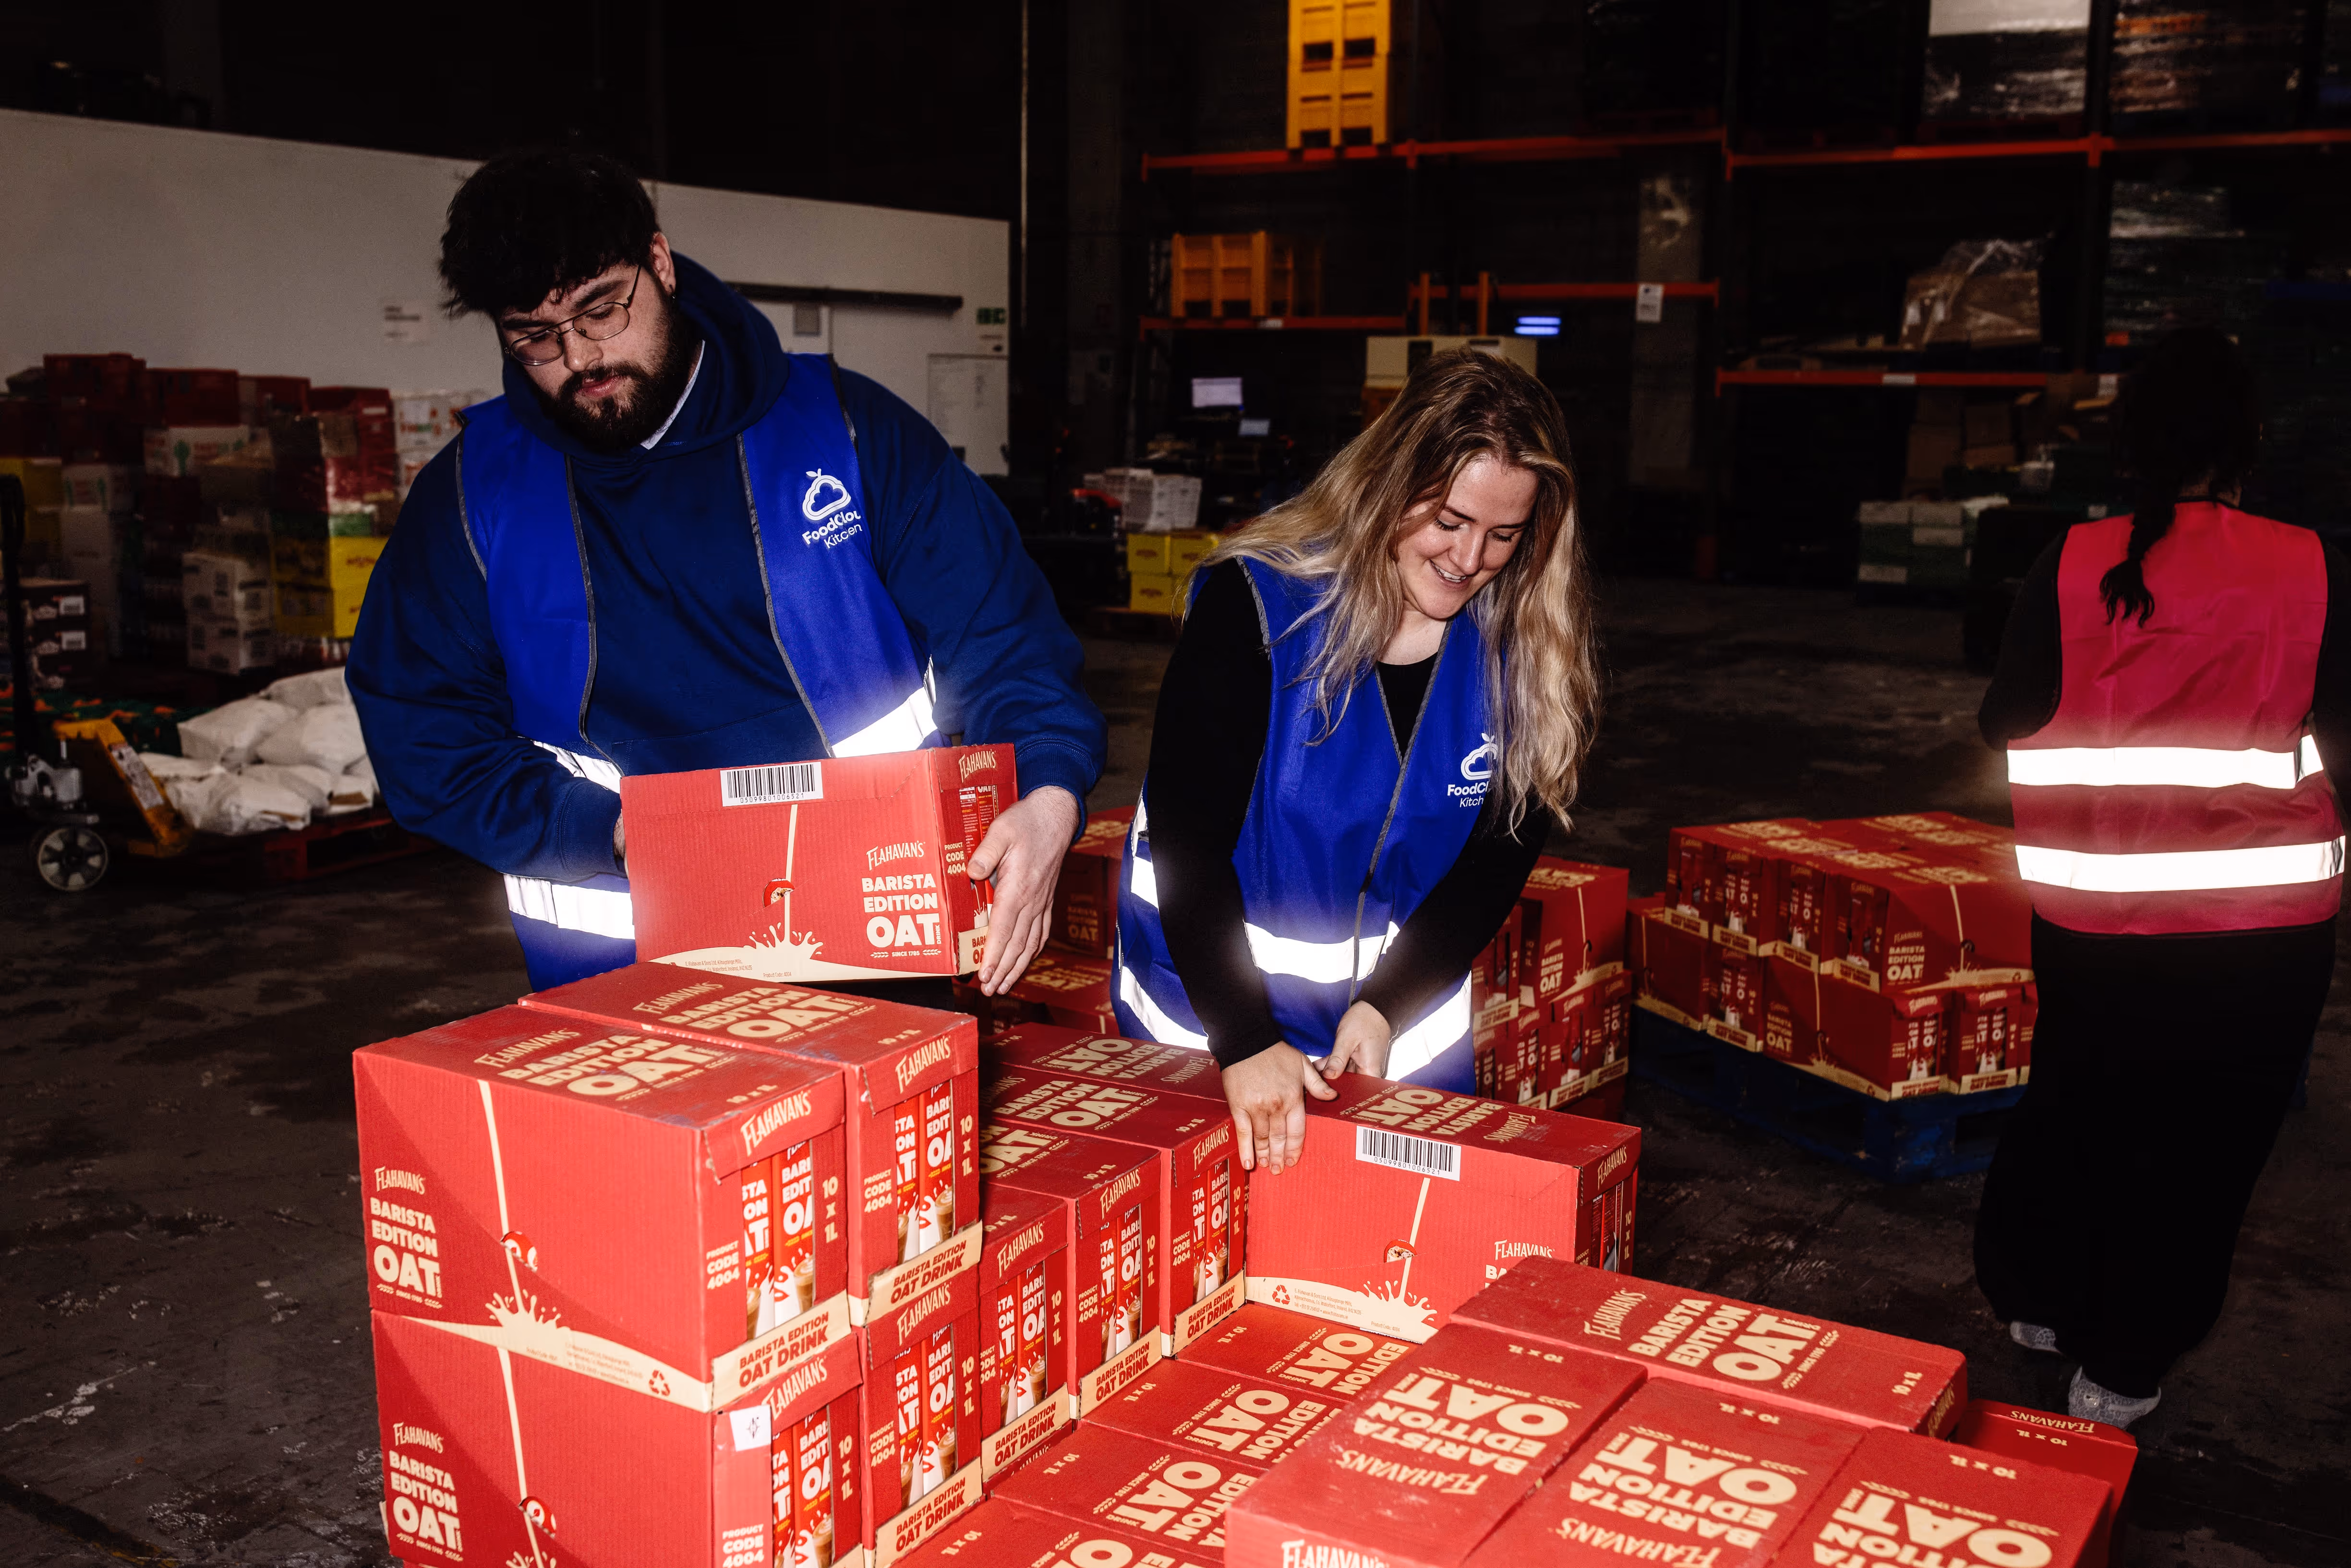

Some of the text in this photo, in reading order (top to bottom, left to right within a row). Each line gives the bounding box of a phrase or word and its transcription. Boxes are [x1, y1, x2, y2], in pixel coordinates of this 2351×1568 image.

[823, 524, 863, 549] Kitcen
[958, 749, 996, 783] FLAHAVAN'S
[740, 792, 805, 804] 05099801006521
[866, 840, 926, 871] FLAHAVAN'S
[944, 842, 963, 850] PRODUCT
[946, 851, 965, 862] CODE
[861, 873, 936, 893] BARISTA
[947, 862, 966, 875] 4004
[863, 893, 938, 913] EDITION
[866, 913, 940, 948] OAT
[1888, 954, 1925, 965] EDITION
[1889, 945, 1925, 954] BARISTA
[1540, 972, 1562, 993] OAT
[1887, 964, 1924, 980] OAT
[659, 987, 781, 1024] BARISTA
[687, 990, 811, 1030] EDITION
[726, 995, 855, 1037] OAT
[498, 1035, 641, 1079] BARISTA
[1049, 1039, 1133, 1072] OAT
[1767, 1032, 1792, 1052] OAT
[528, 1039, 672, 1086] EDITION
[567, 1044, 715, 1095] OAT
[1087, 1043, 1164, 1076] EDITION
[1112, 1048, 1187, 1079] BARISTA
[993, 1080, 1074, 1114] BARISTA
[1016, 1083, 1101, 1120] EDITION
[1050, 1087, 1143, 1126] OAT
[1357, 1089, 1444, 1126] OAT
[1401, 1096, 1477, 1131] EDITION
[1430, 1102, 1505, 1136] BARISTA
[864, 1169, 892, 1185] PRODUCT
[1374, 1157, 1441, 1175] 05099801006521
[864, 1179, 892, 1199] CODE
[864, 1193, 892, 1213] 4004
[370, 1197, 436, 1233] BARISTA
[372, 1219, 438, 1257] EDITION
[706, 1240, 739, 1260] PRODUCT
[1173, 1230, 1190, 1245] PRODUCT
[1173, 1239, 1190, 1255] CODE
[374, 1245, 440, 1296] OAT
[707, 1252, 739, 1274] CODE
[1172, 1250, 1191, 1266] 4004
[707, 1267, 740, 1290] 4004
[891, 1253, 965, 1303] OAT DRINK
[1078, 1285, 1097, 1300] PRODUCT
[1079, 1293, 1097, 1311] CODE
[1079, 1304, 1098, 1323] 4004
[1187, 1295, 1234, 1339] OAT DRINK
[1321, 1301, 1336, 1309] Waterford,
[1627, 1298, 1713, 1358] BARISTA
[1665, 1304, 1752, 1367] EDITION
[739, 1326, 828, 1387] OAT DRINK
[1284, 1333, 1374, 1388] OAT
[1712, 1313, 1818, 1382] OAT
[1096, 1352, 1149, 1401] OAT DRINK
[1278, 1373, 1309, 1384] DRINK
[1330, 1342, 1410, 1395] EDITION
[1191, 1389, 1290, 1452] OAT
[1383, 1376, 1569, 1436] OAT
[870, 1421, 894, 1441] PRODUCT
[870, 1431, 894, 1454] CODE
[995, 1443, 1020, 1467] OAT
[1020, 1413, 1055, 1450] DRINK
[1184, 1435, 1217, 1447] DRINK
[1239, 1399, 1327, 1460] EDITION
[1353, 1417, 1529, 1475] BARISTA
[1364, 1401, 1547, 1459] EDITION
[389, 1450, 455, 1491] BARISTA
[871, 1444, 895, 1467] 4004
[1595, 1436, 1797, 1505] OAT
[1949, 1455, 2017, 1480] 10 x 1L
[390, 1472, 458, 1514] EDITION
[1112, 1461, 1221, 1532] OAT
[1578, 1463, 1777, 1531] EDITION
[393, 1496, 460, 1550] OAT
[723, 1524, 764, 1539] PRODUCT
[896, 1489, 965, 1552] OAT DRINK
[1106, 1514, 1141, 1527] DRINK
[1569, 1481, 1762, 1550] BARISTA
[1832, 1493, 2052, 1568] OAT
[723, 1535, 764, 1554] CODE
[723, 1549, 764, 1568] 4004
